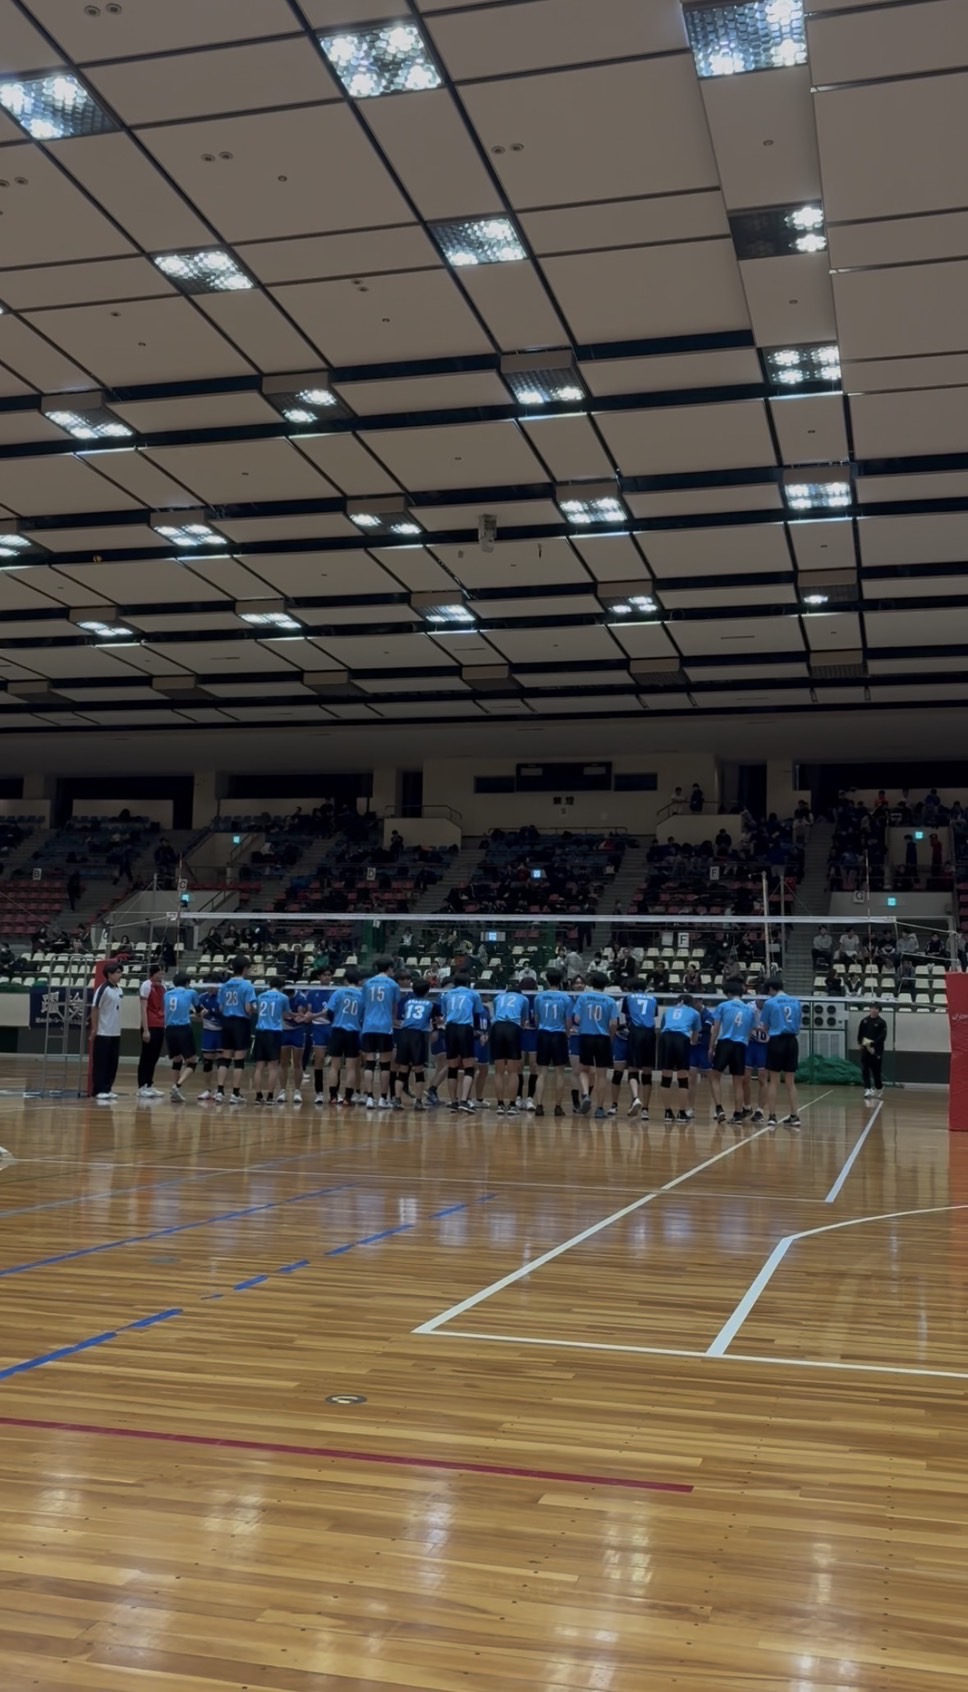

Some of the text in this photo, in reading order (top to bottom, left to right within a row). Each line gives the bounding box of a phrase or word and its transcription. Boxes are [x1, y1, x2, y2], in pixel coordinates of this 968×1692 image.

[369, 986, 385, 1002] 15
[169, 997, 177, 1011] 9
[259, 1001, 275, 1017] 21
[342, 998, 358, 1016] 20
[450, 995, 466, 1010] 17
[544, 1002, 558, 1019] 11
[637, 999, 648, 1015] 7
[405, 1005, 425, 1019] 13
[587, 1004, 603, 1021] 10
[734, 1011, 743, 1026] 4
[784, 1006, 792, 1022] 2
